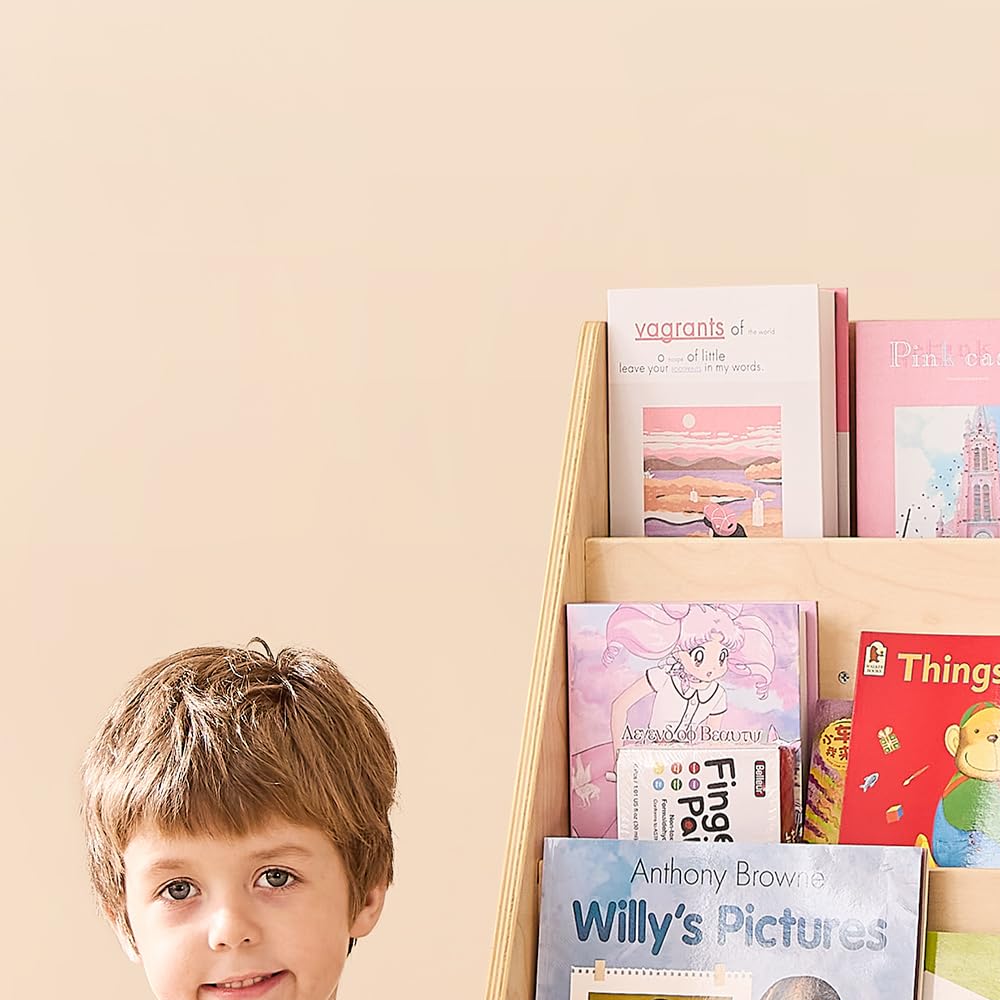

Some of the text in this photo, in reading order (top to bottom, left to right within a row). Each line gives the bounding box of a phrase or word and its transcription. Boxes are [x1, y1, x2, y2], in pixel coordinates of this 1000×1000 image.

[634, 317, 725, 343] vagrants
[730, 320, 744, 336] of
[687, 349, 698, 362] of
[701, 349, 726, 362] little
[889, 339, 955, 368] Pink
[619, 362, 645, 374] leave
[647, 364, 669, 376] your
[704, 363, 713, 372] in
[715, 364, 729, 374] my
[732, 361, 764, 372] words.
[630, 857, 826, 894] Anthony Browne
[571, 899, 888, 956] Willy's Pictures
